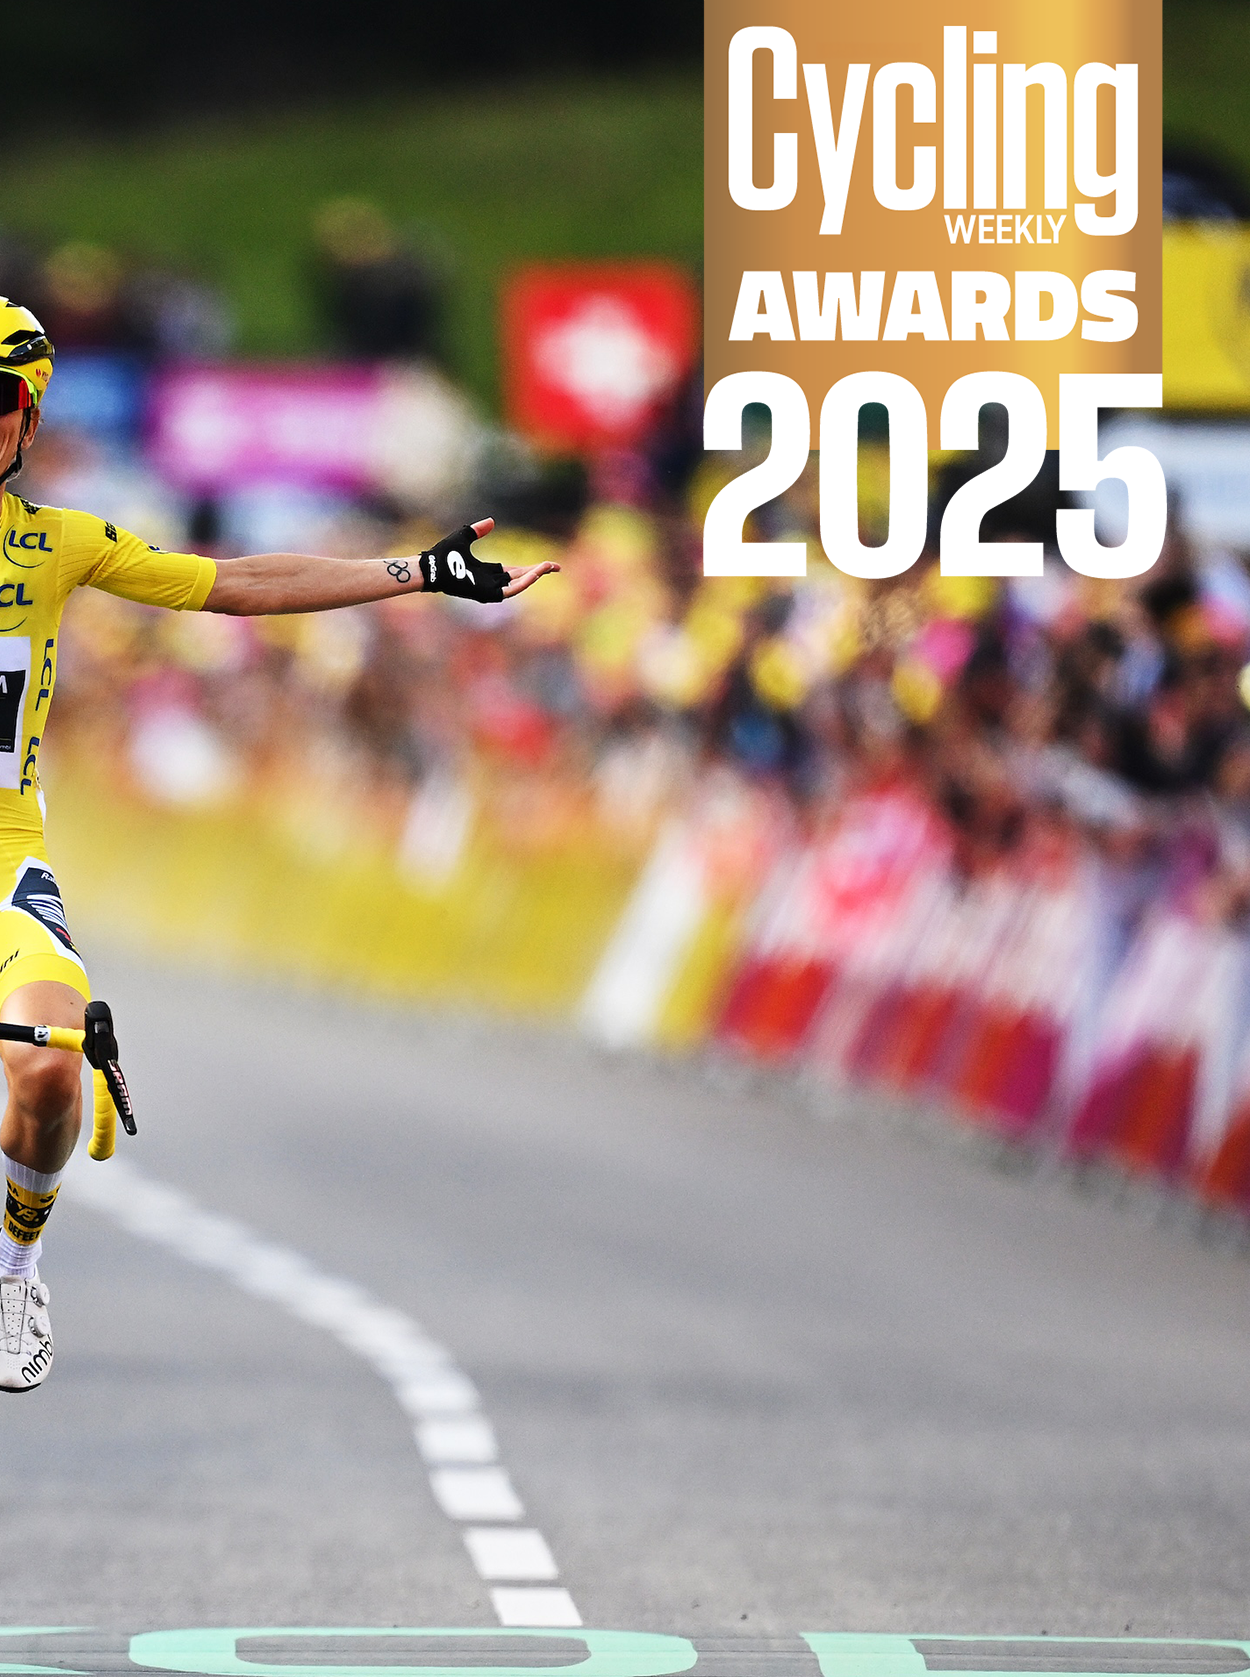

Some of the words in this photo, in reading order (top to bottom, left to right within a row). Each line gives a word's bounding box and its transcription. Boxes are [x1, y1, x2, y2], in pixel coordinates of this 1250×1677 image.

[8, 529, 54, 553] LCL
[35, 638, 55, 712] LCL
[20, 736, 40, 796] LCL
[7, 1220, 42, 1241] DEFEET
